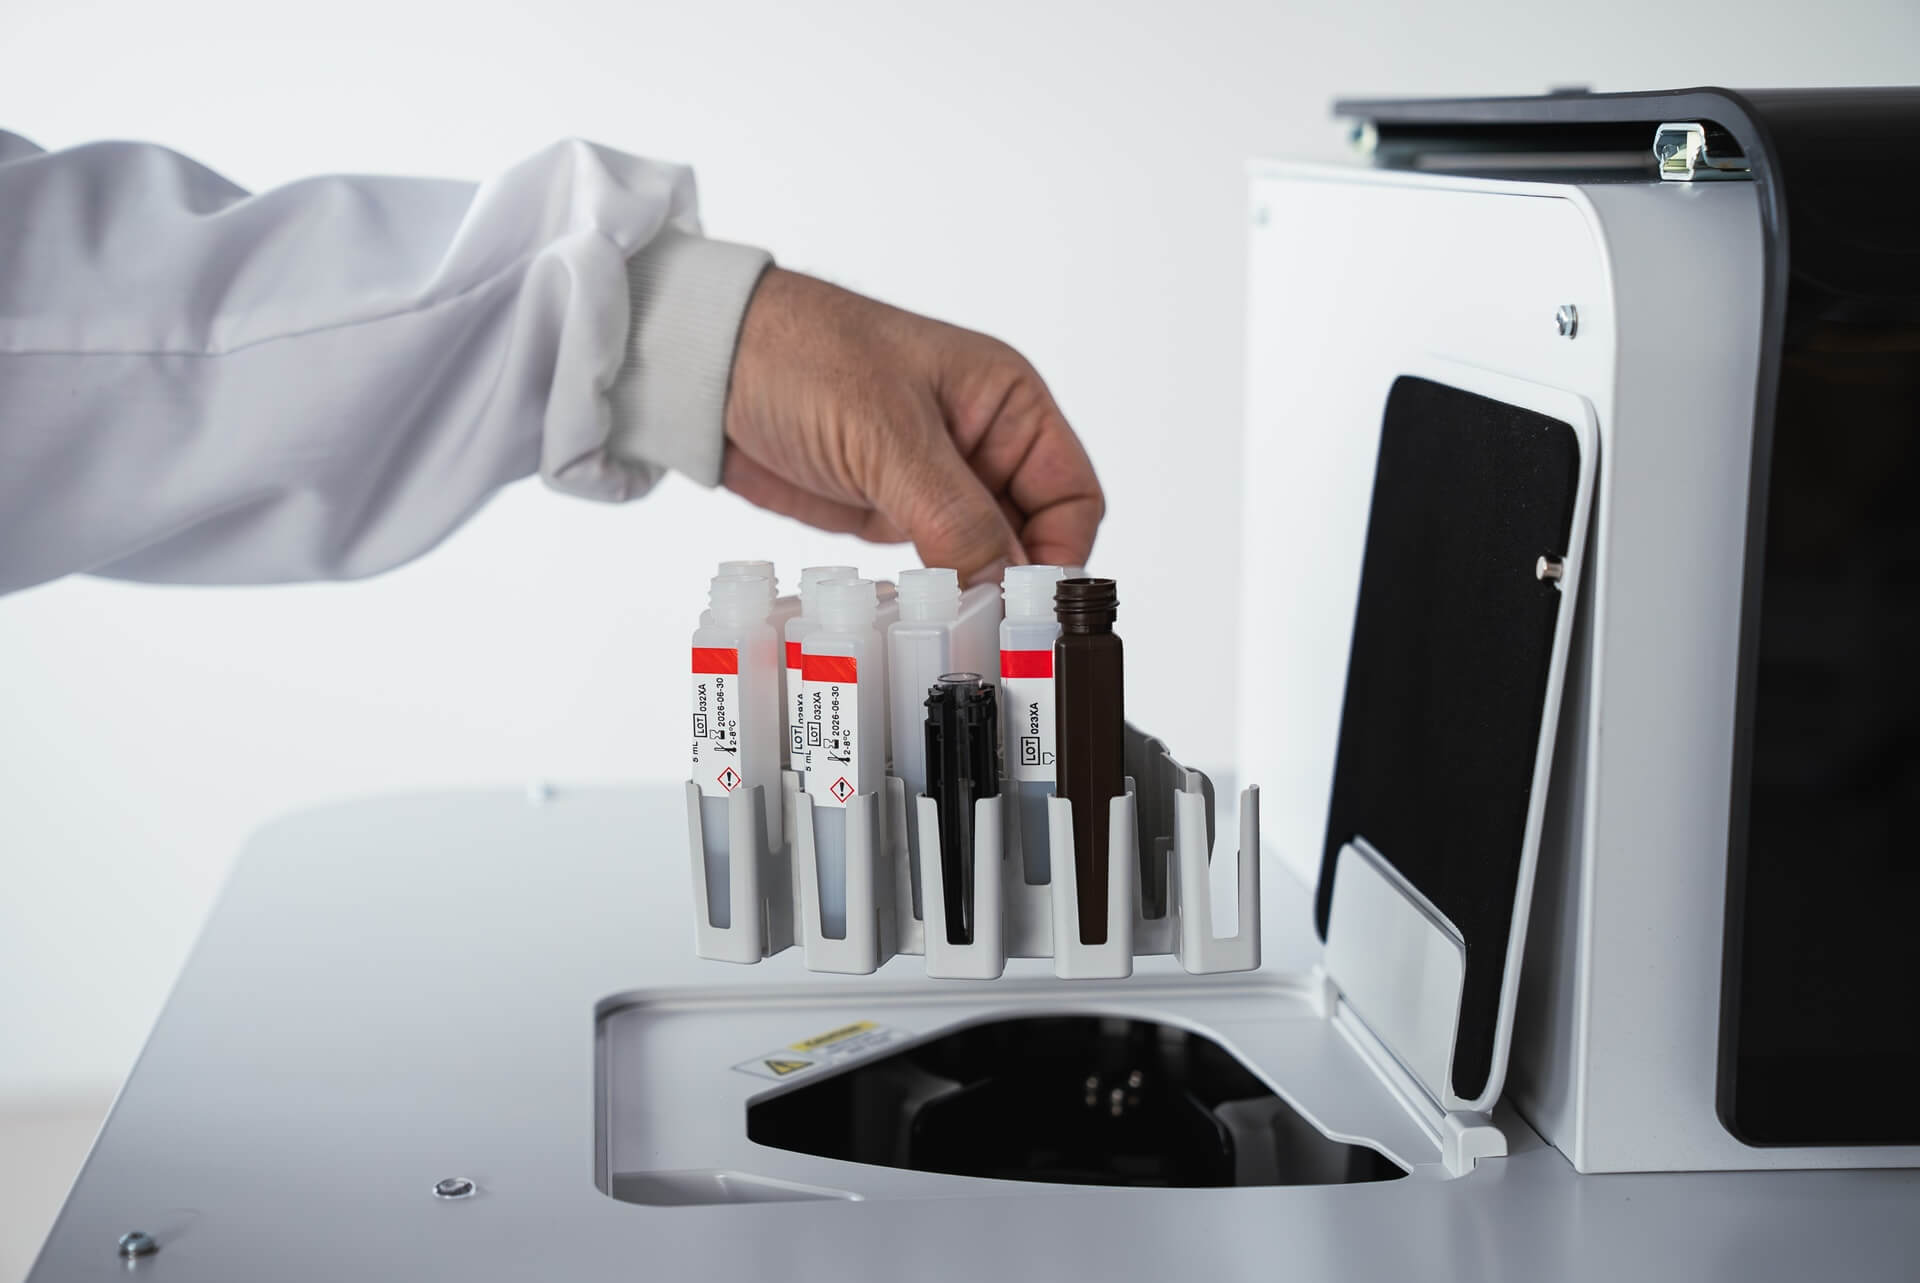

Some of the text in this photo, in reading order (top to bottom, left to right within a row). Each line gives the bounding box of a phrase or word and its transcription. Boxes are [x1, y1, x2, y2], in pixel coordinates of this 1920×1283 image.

[696, 683, 707, 734] LOT 032XA
[810, 691, 822, 742] LOT 032XA
[831, 686, 840, 736] 2026-06-30
[1025, 702, 1039, 761] LOT 023XA
[692, 741, 699, 755] mL
[794, 729, 803, 750] LOT
[805, 750, 812, 764] mL
